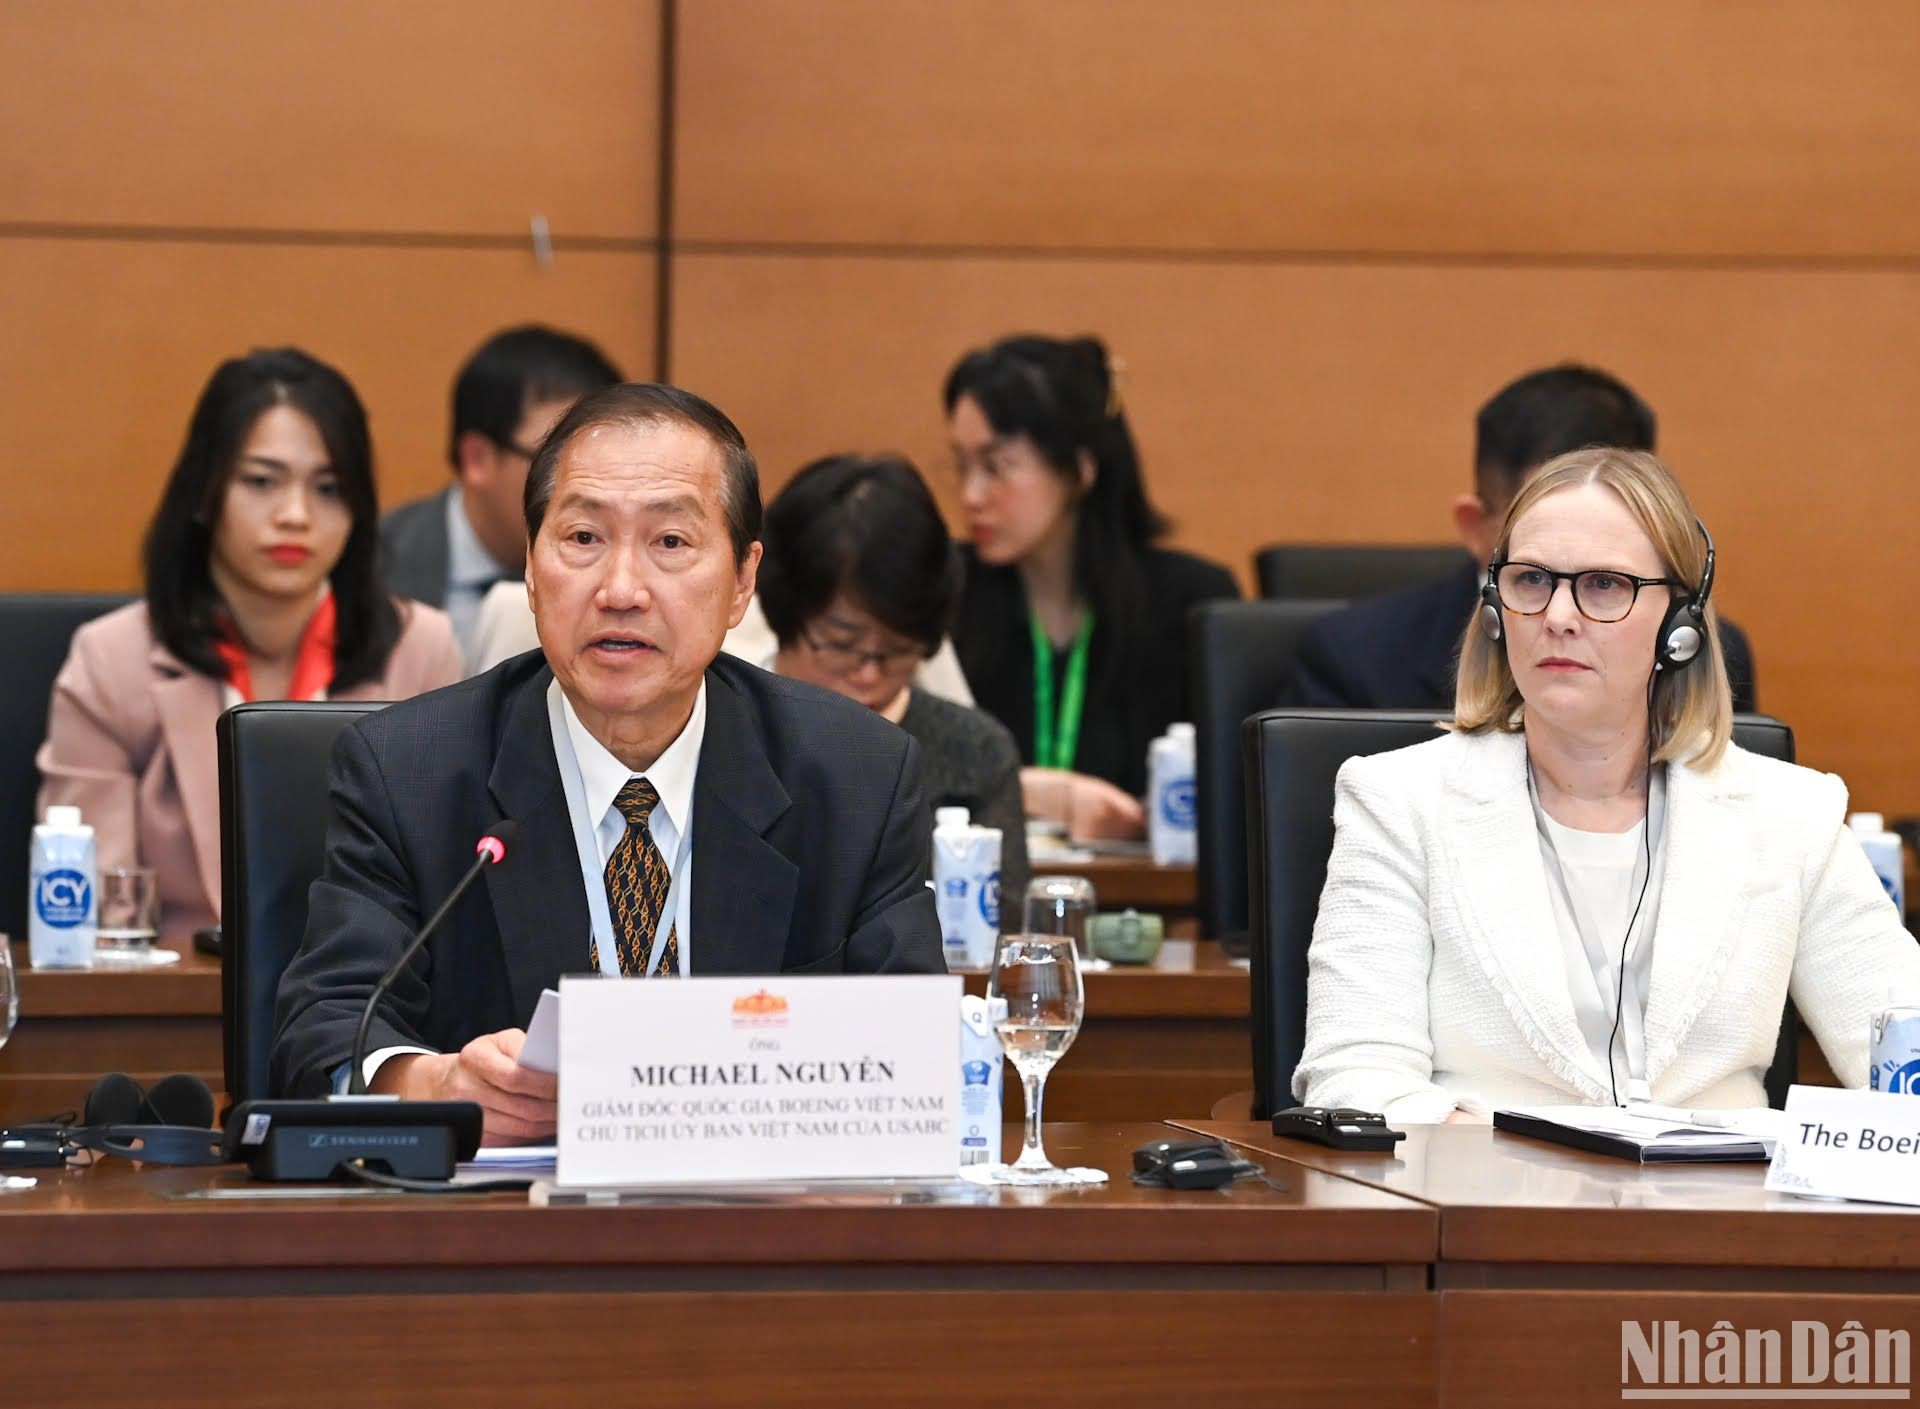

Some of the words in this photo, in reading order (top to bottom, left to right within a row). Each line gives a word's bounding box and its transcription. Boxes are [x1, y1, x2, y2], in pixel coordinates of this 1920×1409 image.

[41, 877, 89, 906] ICY
[631, 1064, 768, 1087] MICHAEL
[776, 1056, 895, 1085] NGUYỄN
[582, 1096, 634, 1118] GIÁM
[682, 1096, 735, 1117] QUỐC
[740, 1098, 773, 1115] GIA
[779, 1097, 850, 1114] BOEING
[854, 1093, 896, 1114] VIỆT
[901, 1096, 944, 1111] NAM
[703, 1122, 744, 1139] BAN
[749, 1118, 791, 1139] VIỆT
[795, 1121, 839, 1137] NAM
[887, 1118, 950, 1136] USABC
[1800, 1123, 1848, 1148] The
[1858, 1128, 1920, 1155] Boei
